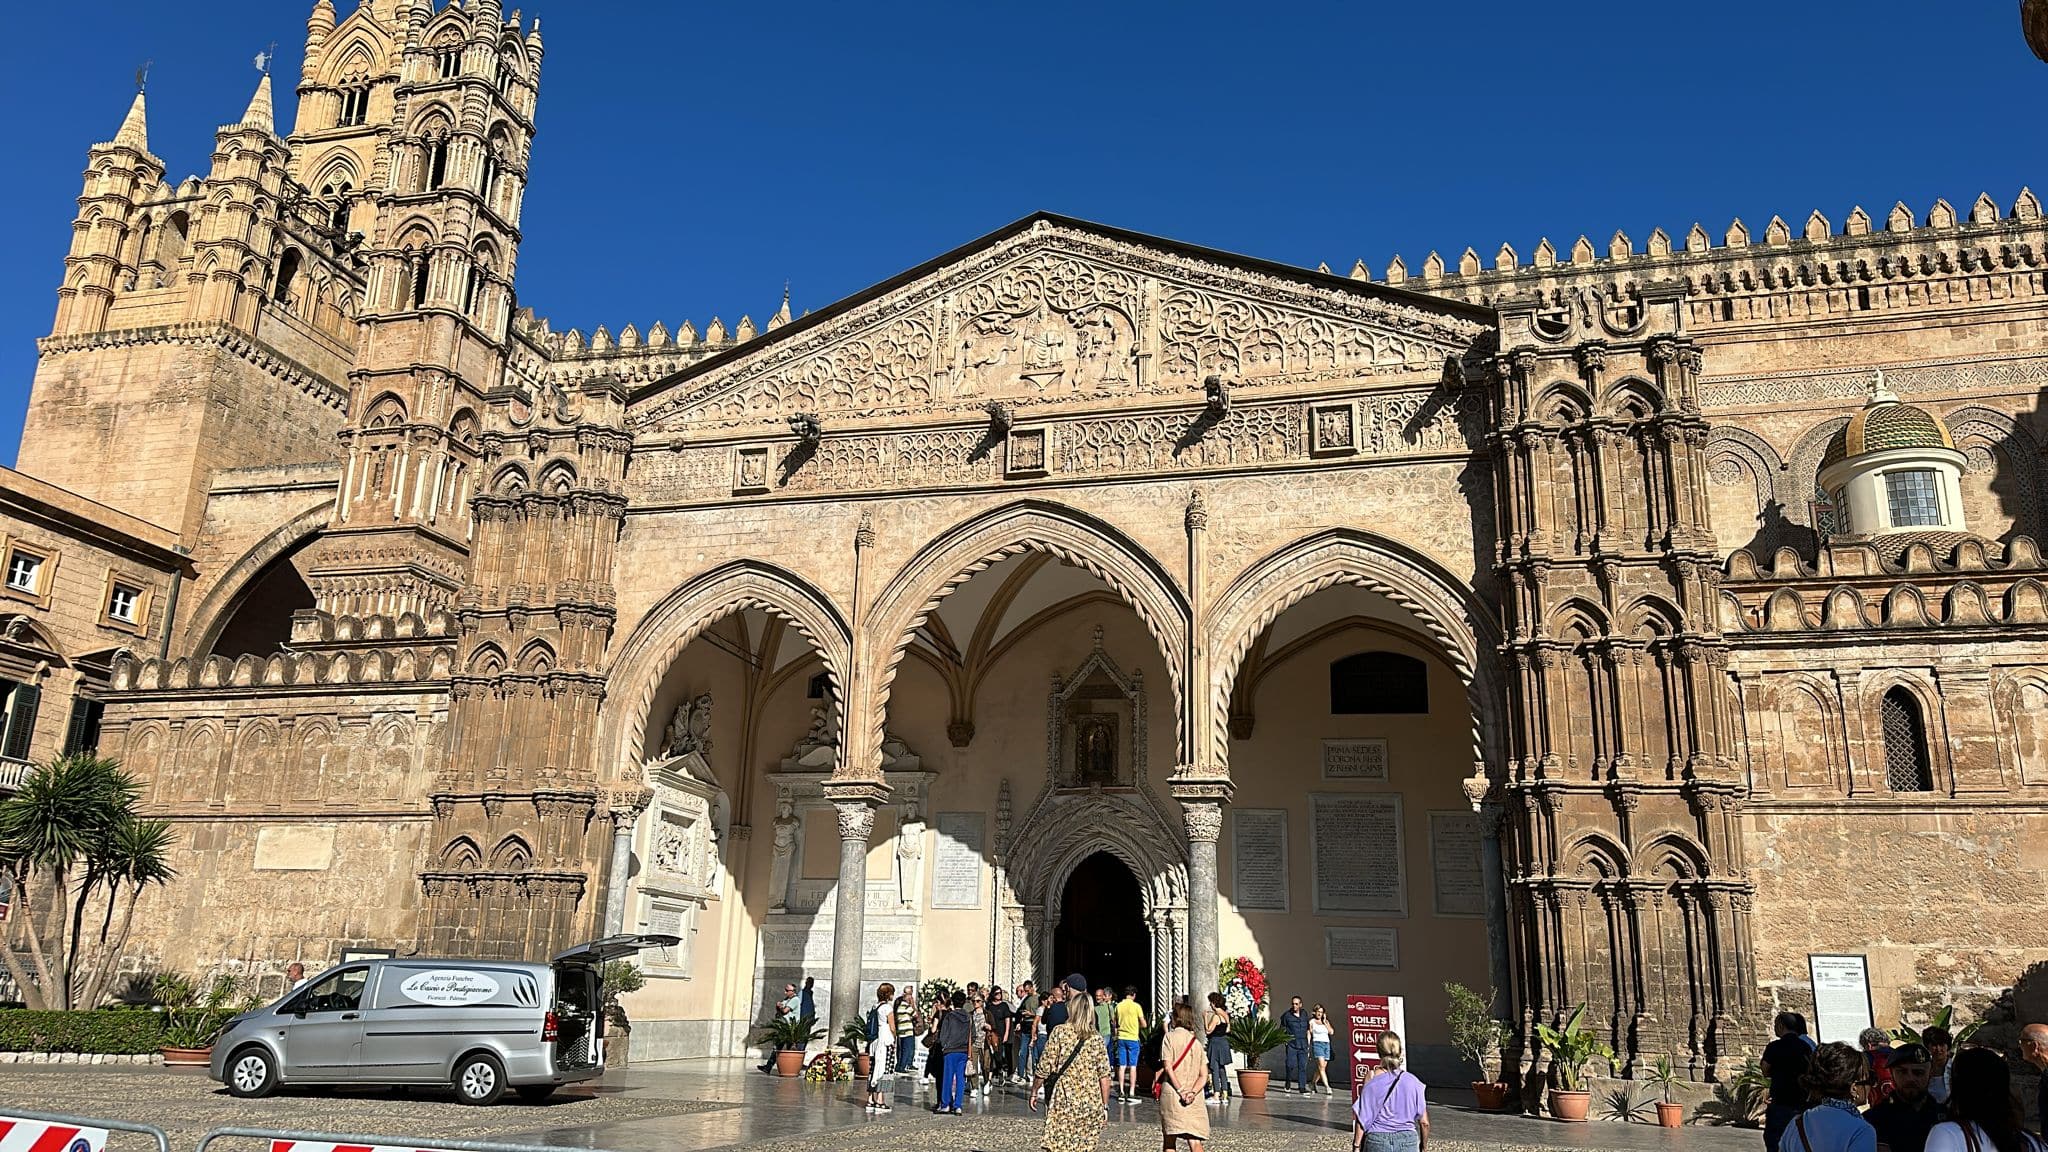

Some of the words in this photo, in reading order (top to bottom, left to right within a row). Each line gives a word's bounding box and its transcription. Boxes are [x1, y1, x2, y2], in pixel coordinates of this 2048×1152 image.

[406, 981, 419, 991] Lo
[419, 981, 440, 992] Cascio
[1350, 1016, 1387, 1024] TOILETS
